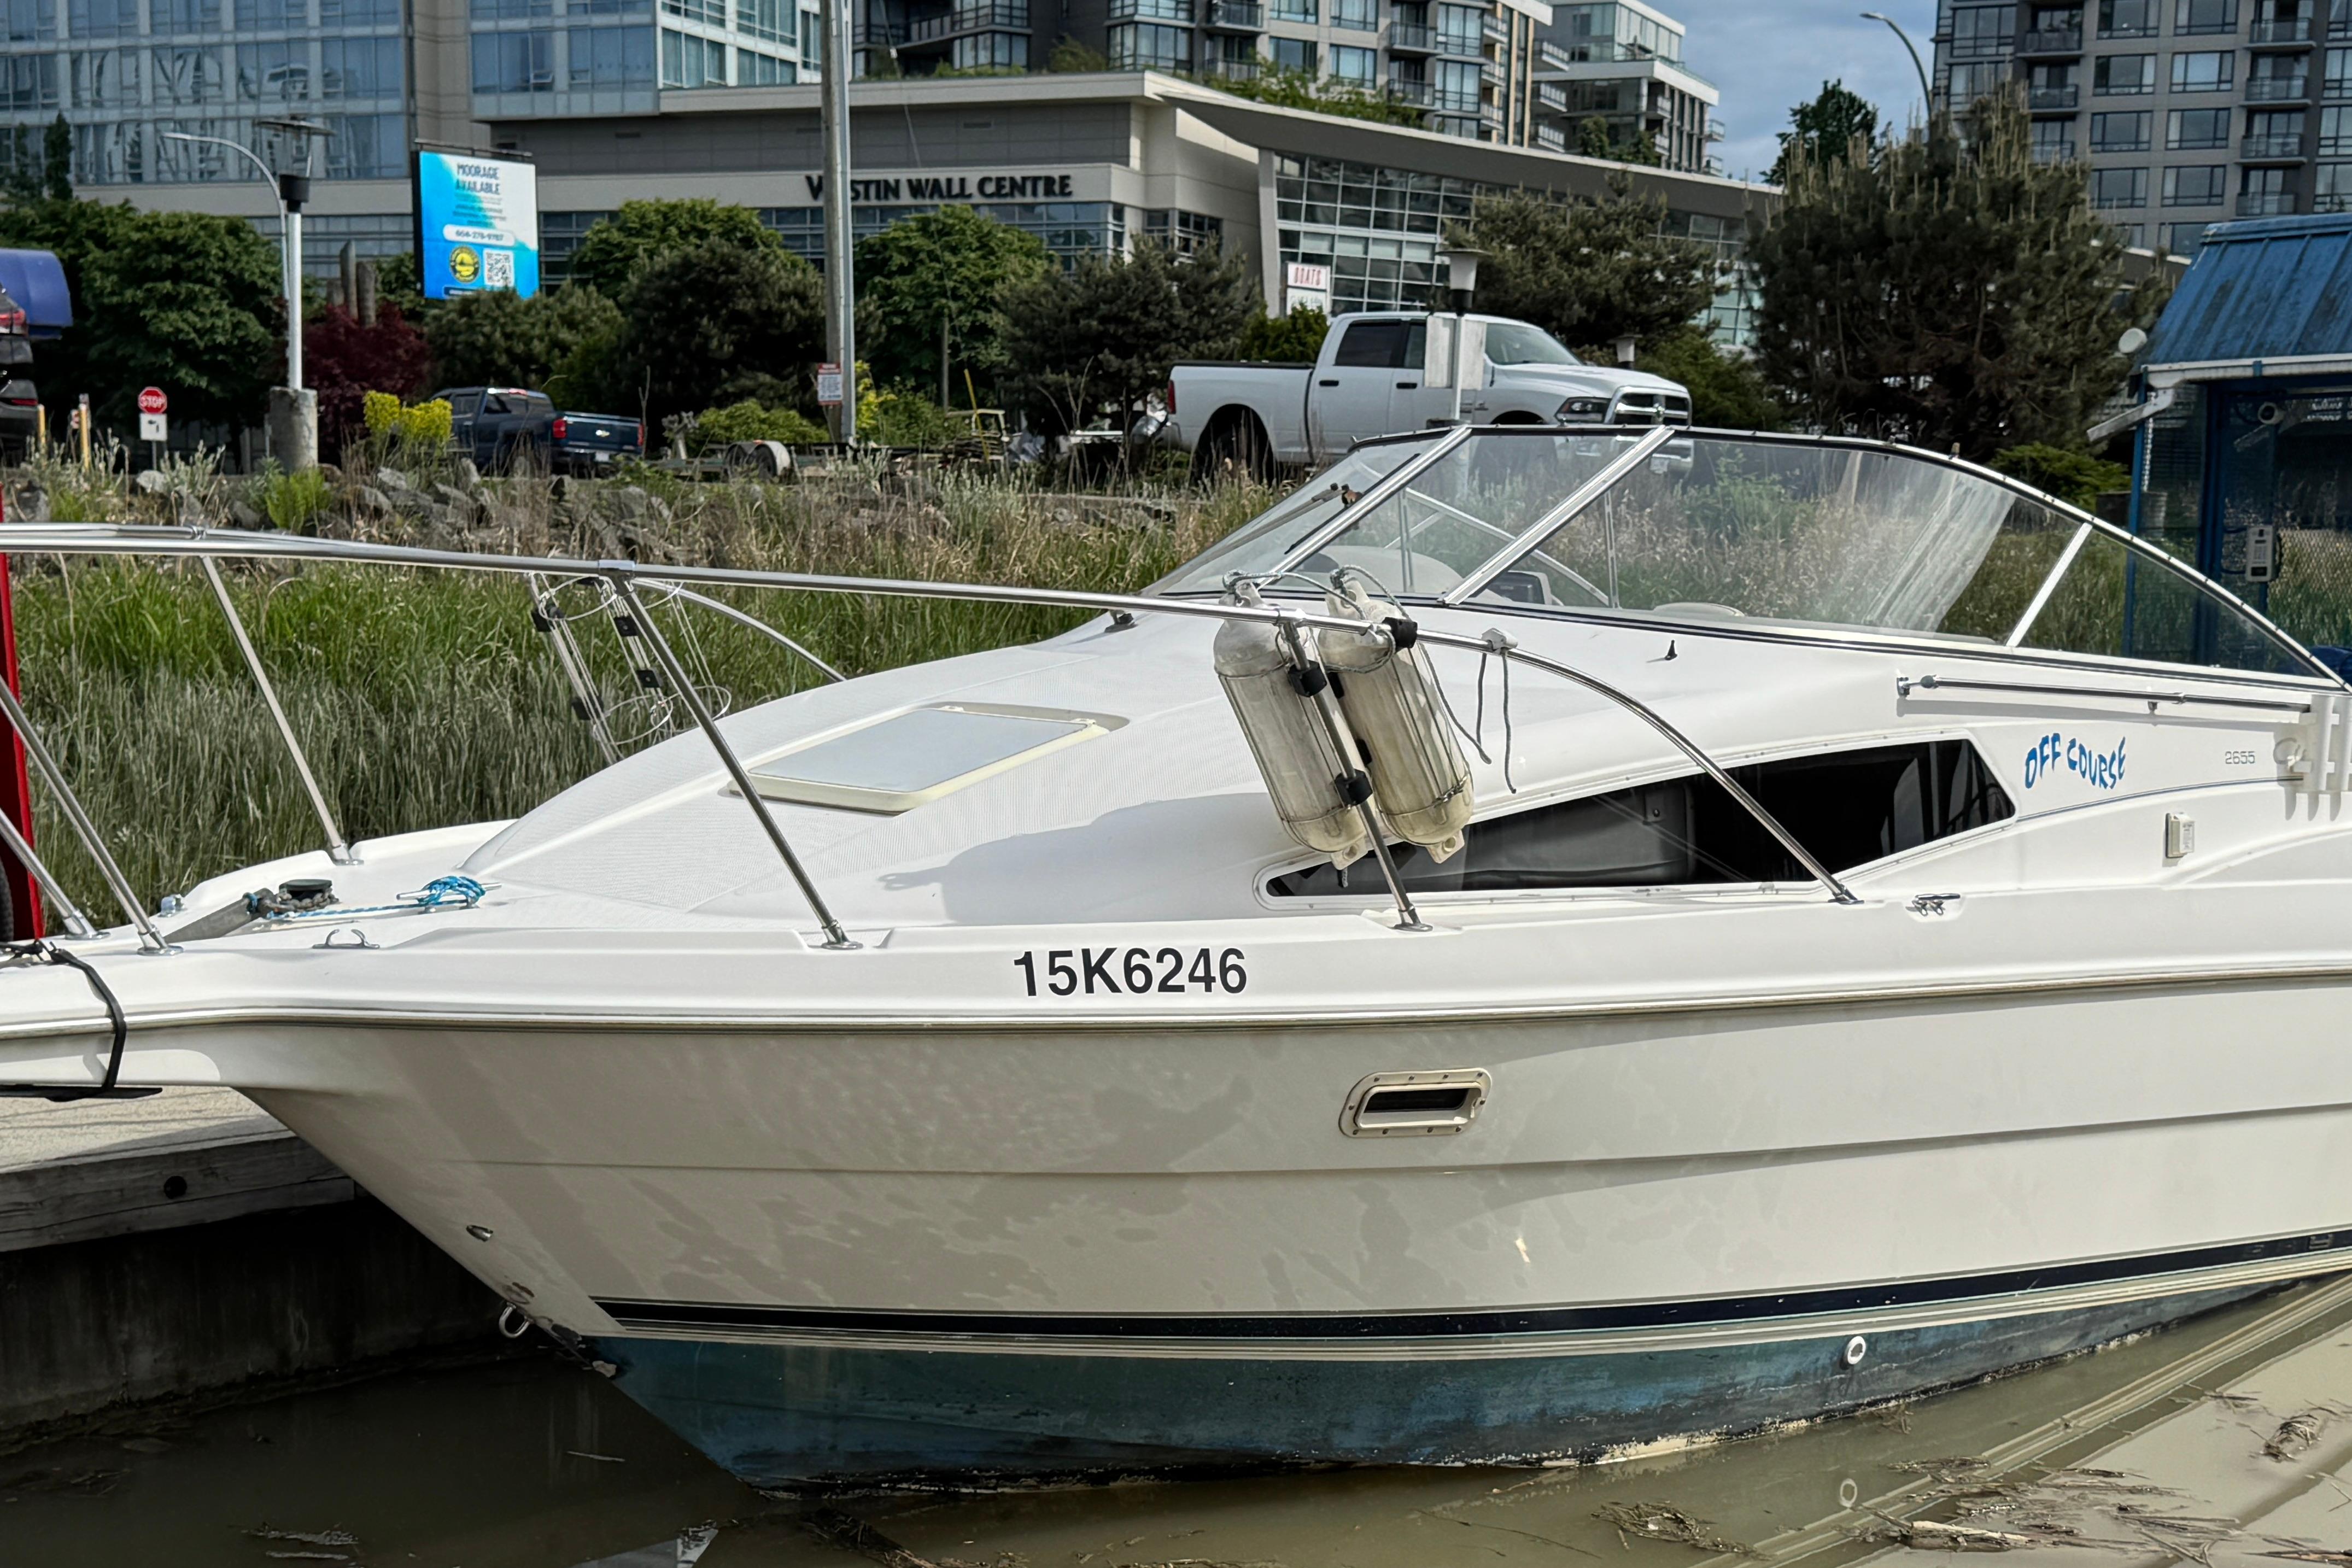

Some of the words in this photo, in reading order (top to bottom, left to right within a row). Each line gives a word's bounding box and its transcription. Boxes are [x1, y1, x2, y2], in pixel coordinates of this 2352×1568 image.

[457, 163, 500, 180] MOORAGE
[455, 179, 501, 195] AVAILABLE
[805, 175, 900, 201] WSTIN
[906, 177, 973, 200] WALL
[977, 175, 1073, 197] CENTRE
[140, 395, 166, 408] STOP
[2025, 733, 2061, 789] OFF
[2067, 736, 2126, 789] COURSE
[2225, 751, 2255, 764] 2655
[1014, 947, 1247, 997] 15K6246
